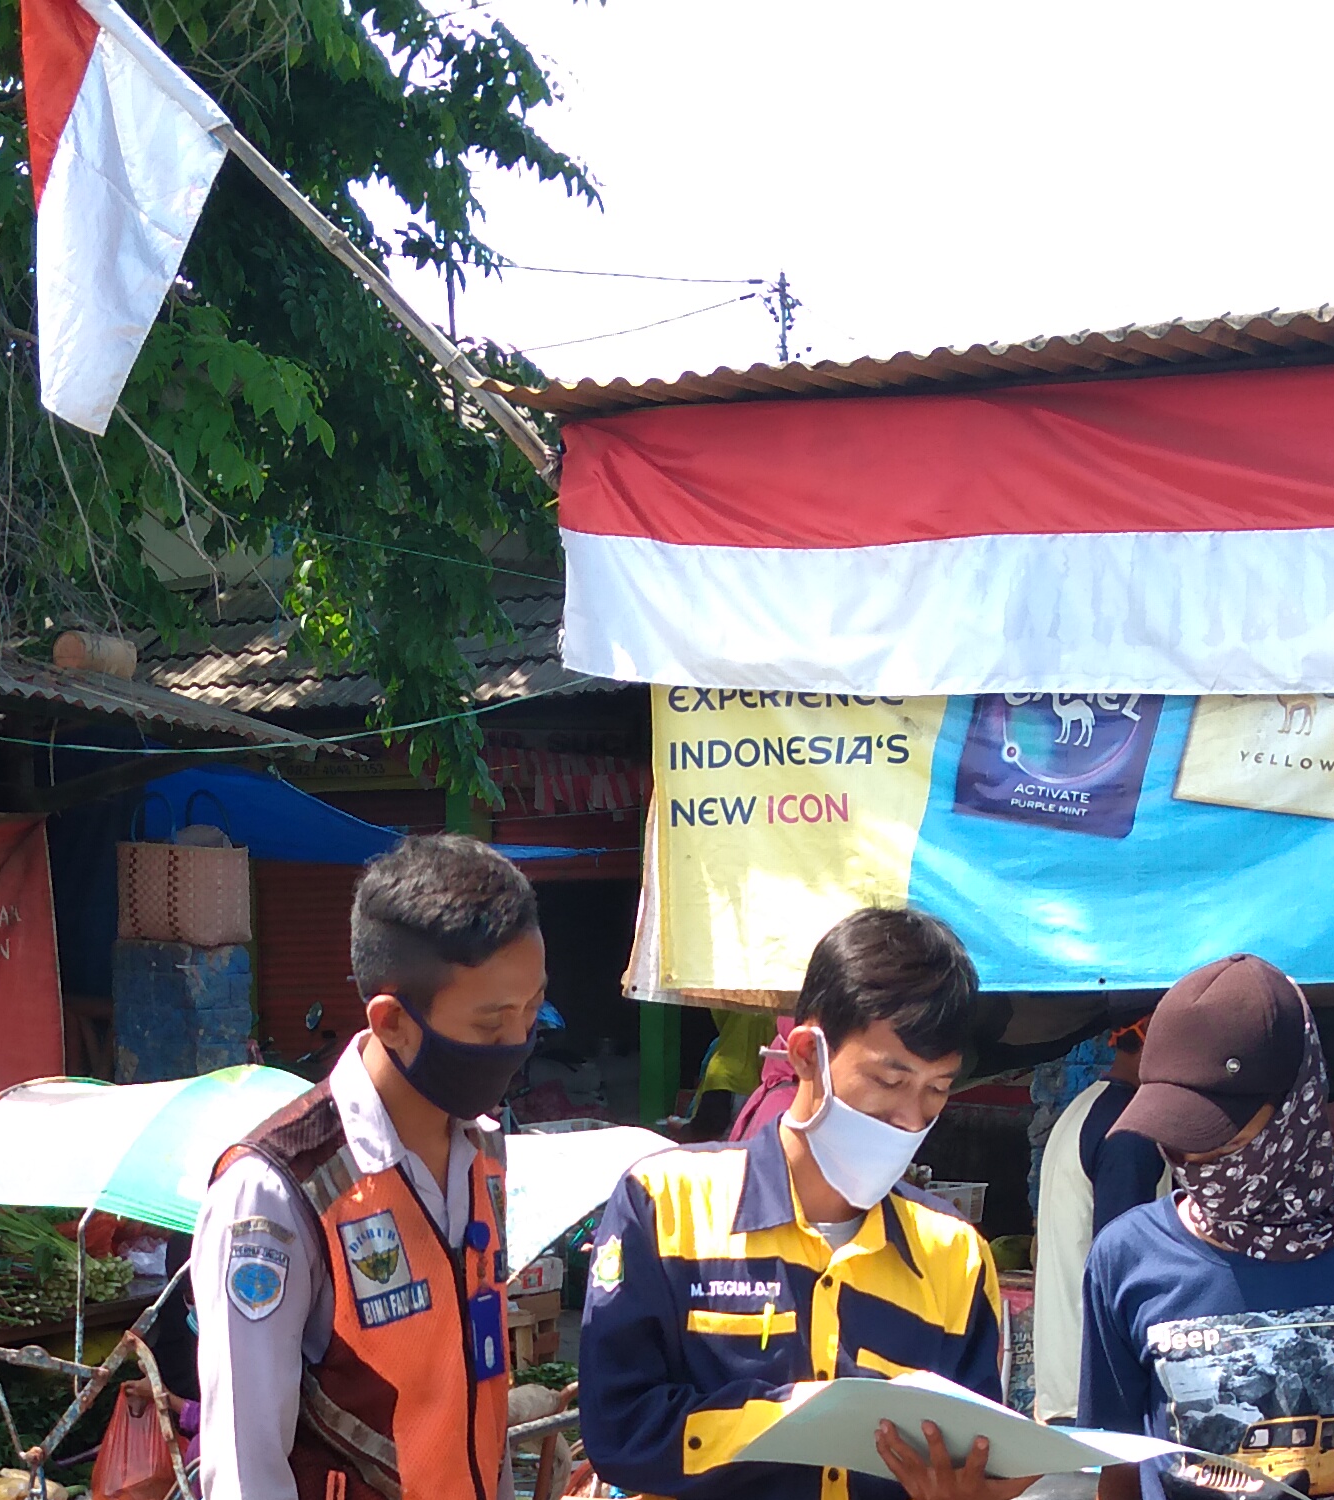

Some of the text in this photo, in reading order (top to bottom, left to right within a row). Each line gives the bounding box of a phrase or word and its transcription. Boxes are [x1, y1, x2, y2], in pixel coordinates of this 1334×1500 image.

[669, 733, 910, 771] INDONESIA'S
[1013, 782, 1092, 805] ACTIVATE
[670, 792, 850, 828] NEW ICON
[1009, 798, 1088, 818] PURPLE MINT
[1157, 1327, 1220, 1352] Jeep
